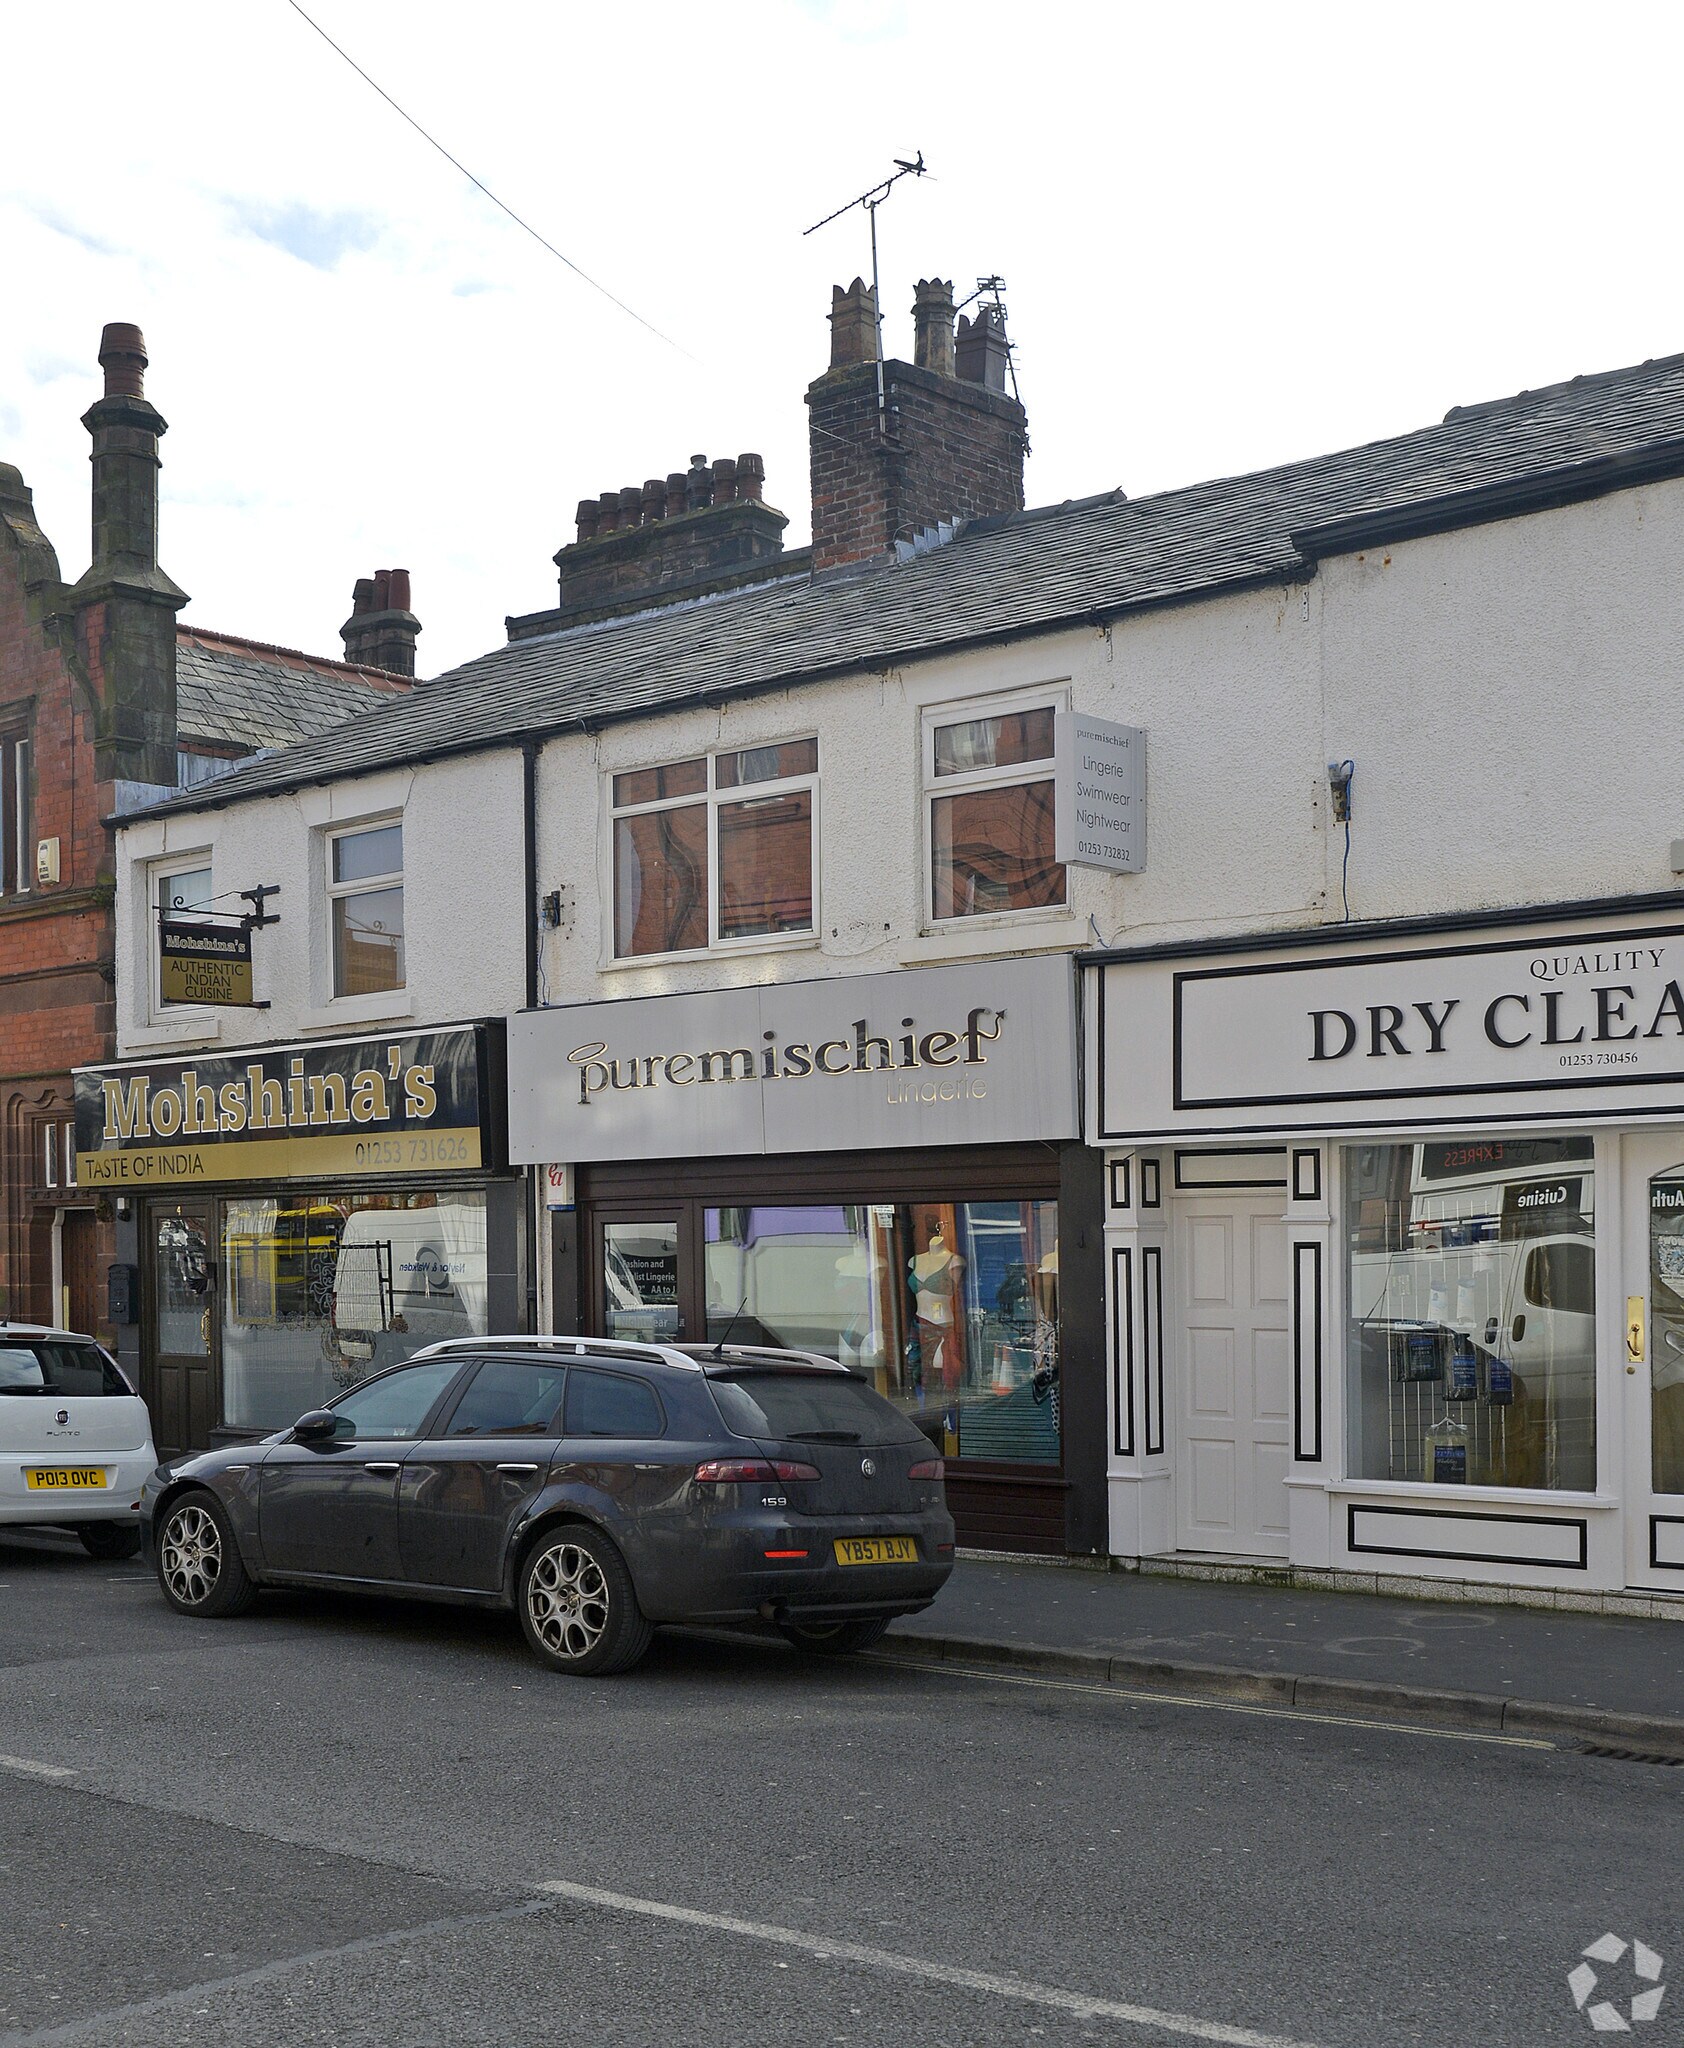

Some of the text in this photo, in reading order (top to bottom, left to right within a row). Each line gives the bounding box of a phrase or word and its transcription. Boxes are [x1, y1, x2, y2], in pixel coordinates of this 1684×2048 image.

[1076, 728, 1131, 748] puremischief
[1083, 756, 1124, 778] Lingerie
[1076, 781, 1131, 807] Swimwear
[1076, 809, 1131, 833] Nightwear
[1078, 840, 1130, 862] 01253 732832
[165, 934, 246, 953] Mohshina's
[171, 960, 244, 976] AUTHENTIC
[1529, 948, 1666, 982] QUALITY
[185, 974, 231, 987] INDIAN
[184, 986, 233, 1000] CUISINE
[1307, 978, 1684, 1062] DRY CLEA
[566, 1007, 1007, 1105] puremischief
[1559, 1051, 1639, 1067] 01253 730456
[101, 1045, 438, 1140] Mohshina's
[885, 1072, 988, 1108] Lingerie
[355, 1137, 468, 1166] 01253 731626
[85, 1153, 204, 1179] TASTE OF INDIA
[650, 1259, 664, 1269] and
[646, 1271, 675, 1283] Lingerie
[651, 1285, 662, 1294] AA
[662, 1285, 671, 1294] to
[35, 1471, 99, 1487] PO13 OVC
[761, 1497, 787, 1507] 159
[841, 1539, 912, 1562] YB57 BJY
